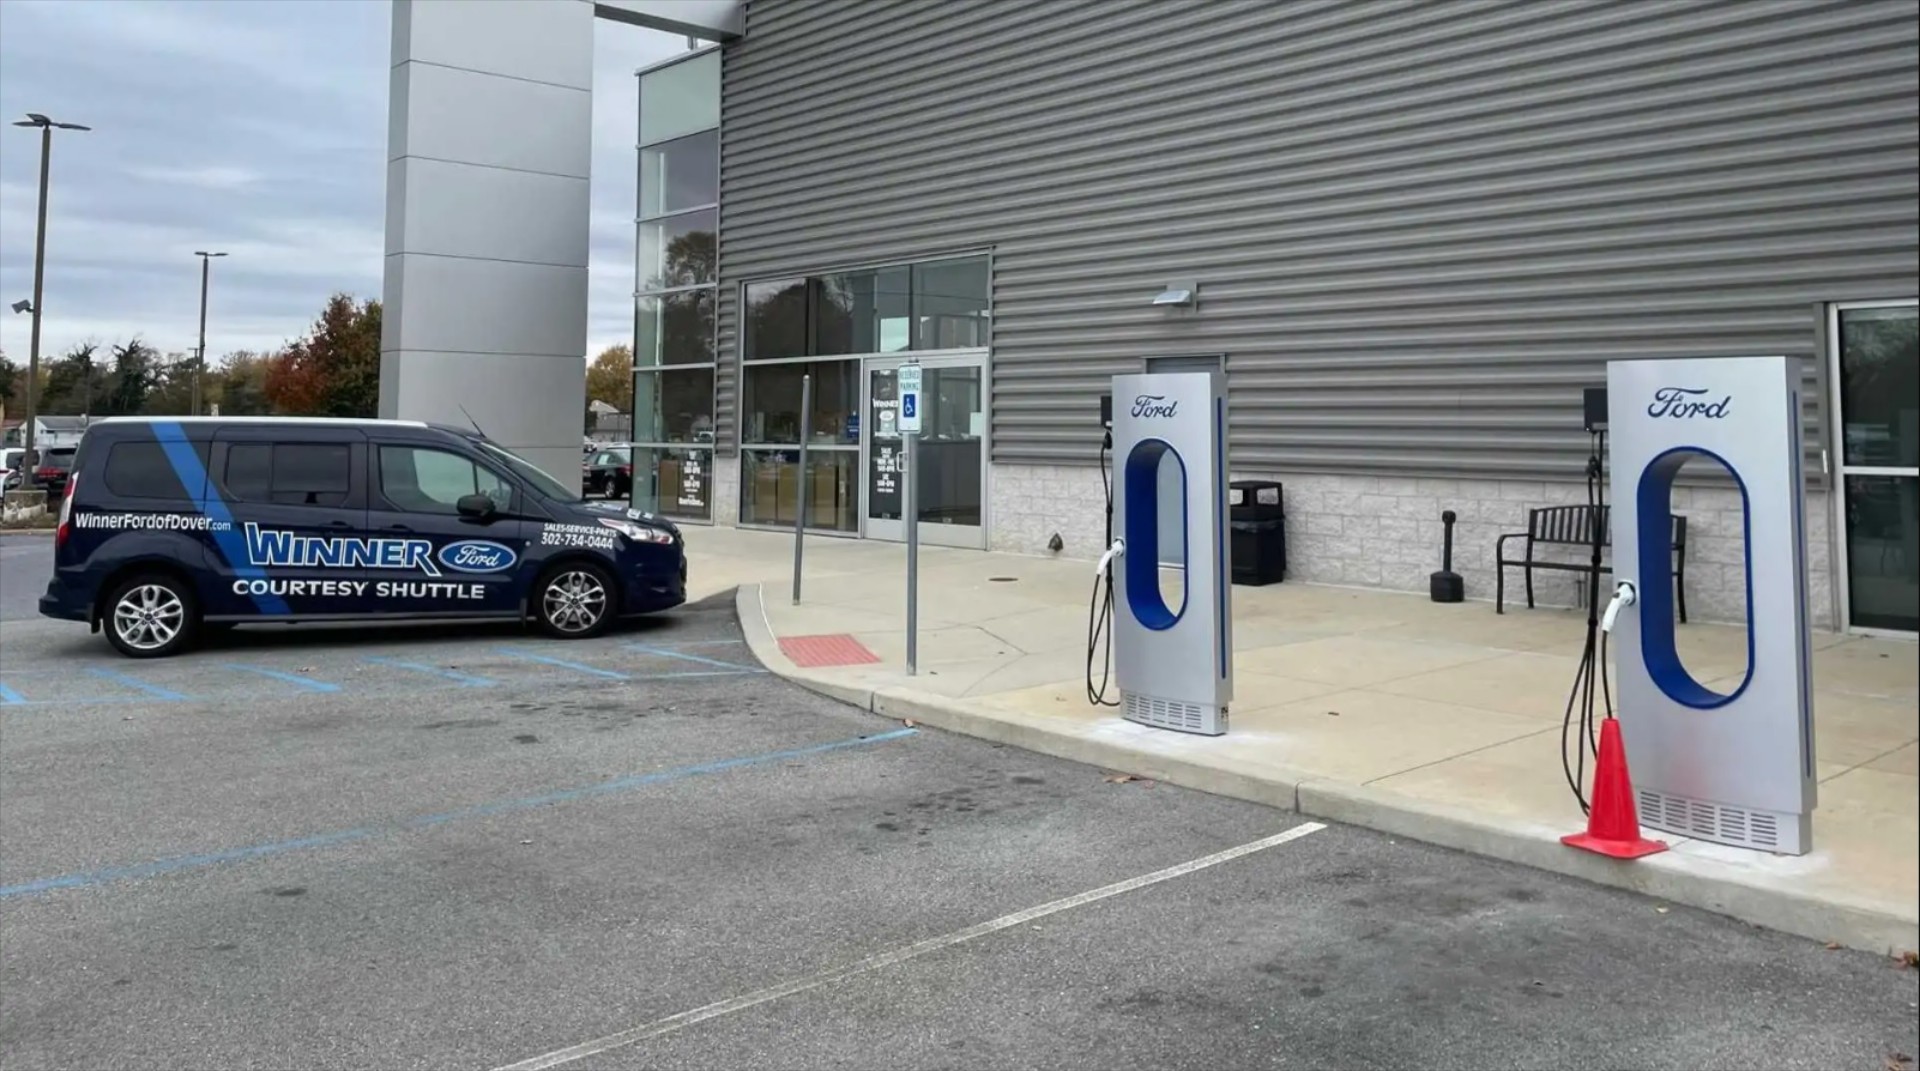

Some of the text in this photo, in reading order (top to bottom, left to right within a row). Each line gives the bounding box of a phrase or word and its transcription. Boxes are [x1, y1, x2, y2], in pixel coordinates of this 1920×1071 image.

[1131, 394, 1178, 418] Ford
[1647, 387, 1731, 419] Ford
[75, 513, 231, 531] WinnerFordofDover.com
[244, 522, 501, 577] WINNER Ford
[541, 532, 613, 550] 302-734-0444
[232, 579, 485, 599] COURTESY SHUTTLE
